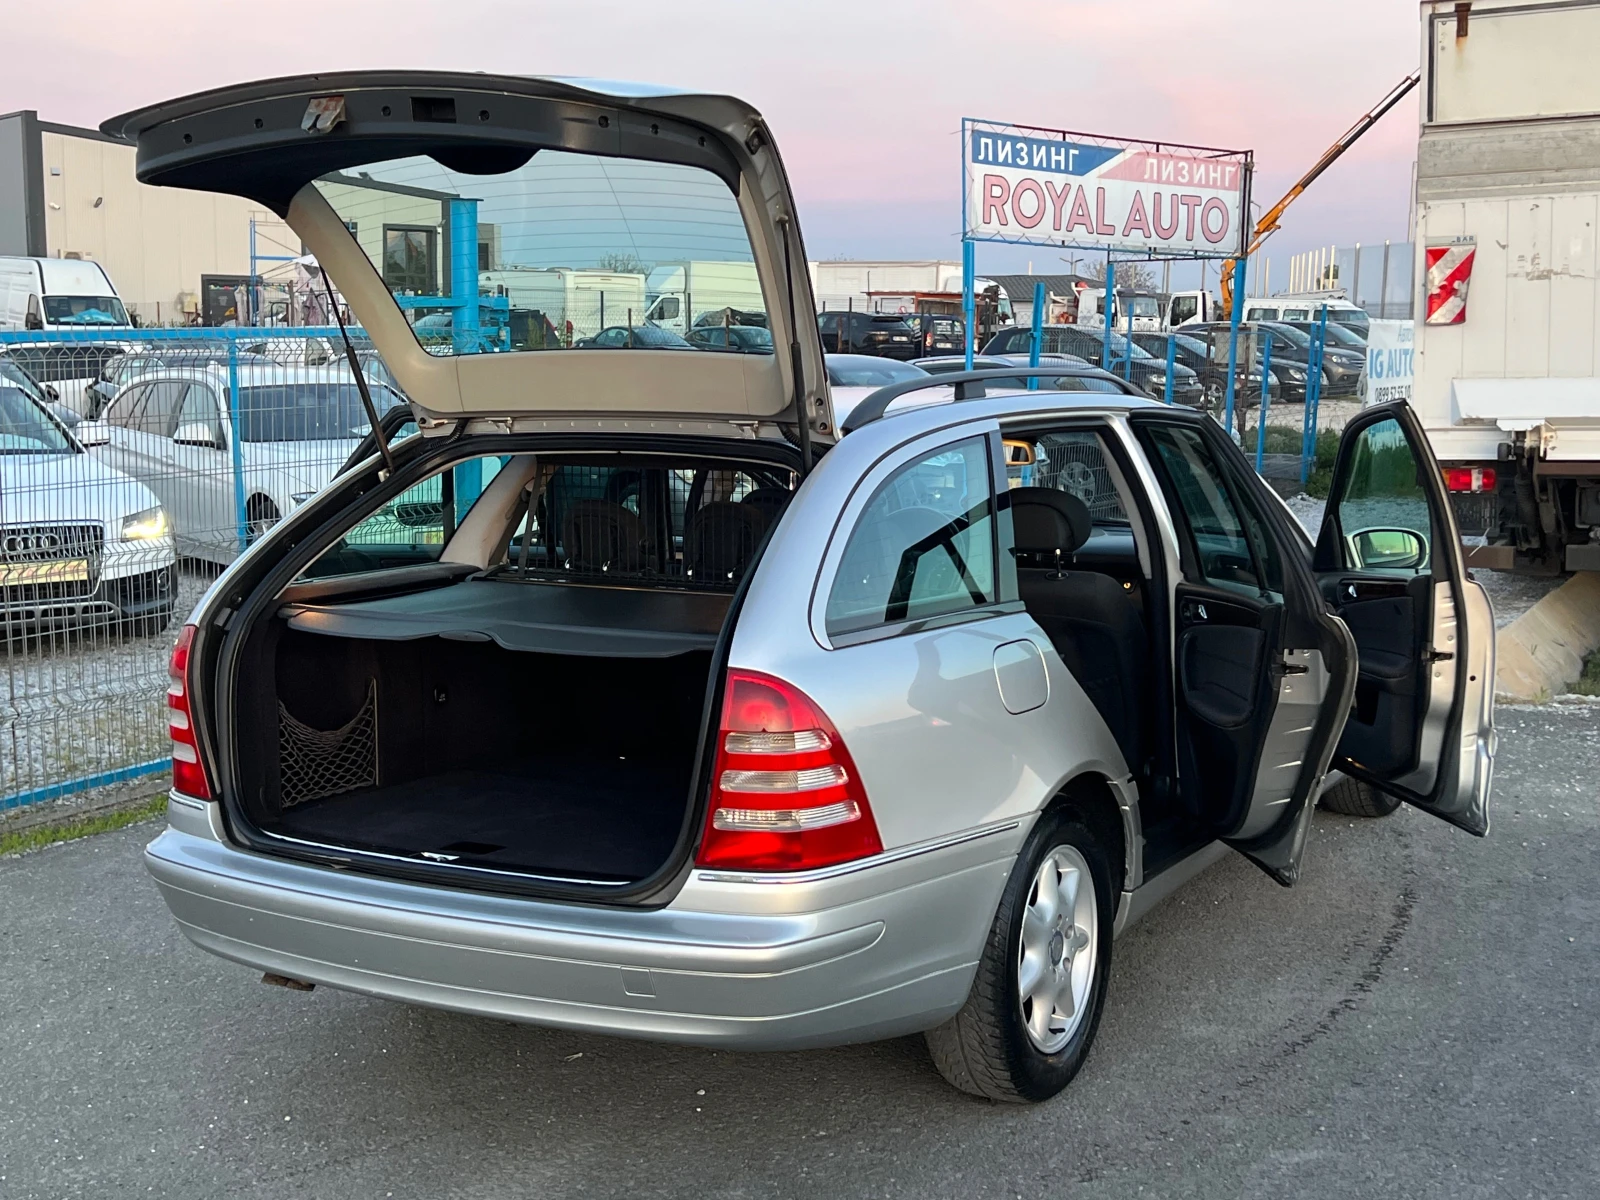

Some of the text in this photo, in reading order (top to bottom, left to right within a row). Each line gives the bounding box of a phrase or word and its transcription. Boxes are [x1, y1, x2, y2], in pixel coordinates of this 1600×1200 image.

[978, 137, 1079, 171] ЛИЗИНГ
[1144, 158, 1236, 188] ЛИЗИНГ
[983, 174, 1229, 244] ROYAL AUTO
[1369, 348, 1384, 379] IG
